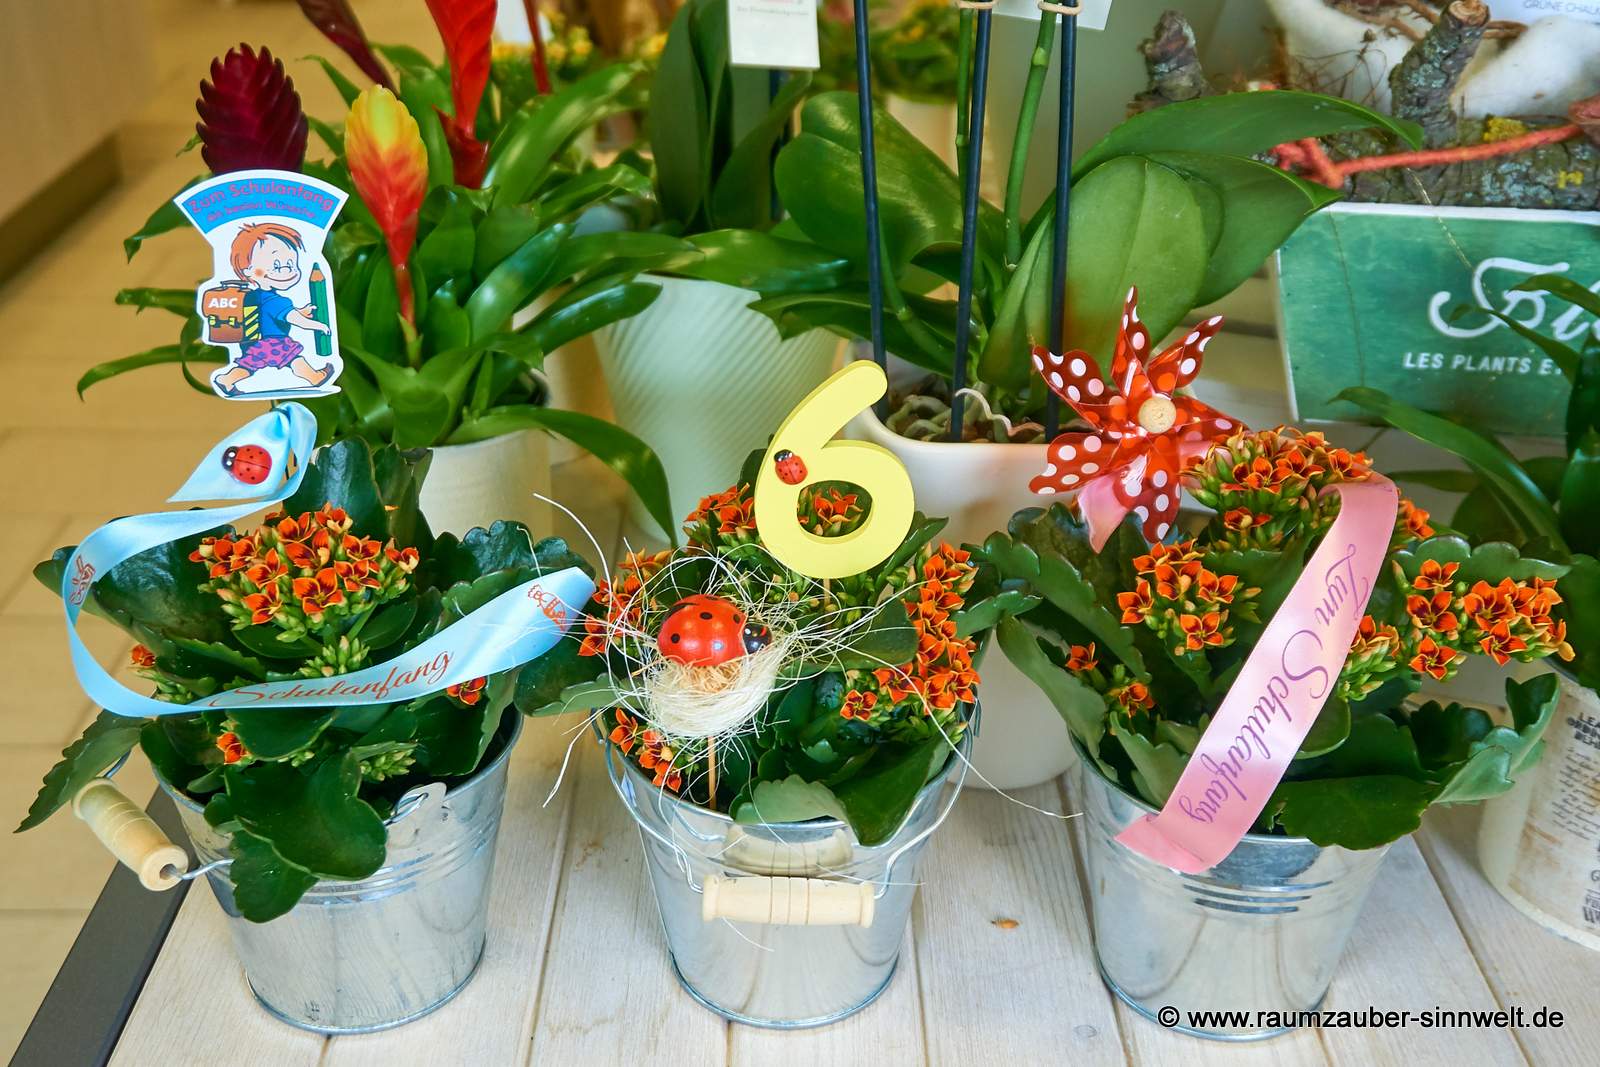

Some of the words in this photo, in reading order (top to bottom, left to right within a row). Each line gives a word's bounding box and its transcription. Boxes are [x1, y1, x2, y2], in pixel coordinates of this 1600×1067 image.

[188, 189, 225, 214] Zum
[228, 181, 335, 212] Schulanfang
[208, 297, 238, 309] ABC
[1403, 352, 1445, 369] LES
[1452, 354, 1532, 374] PLANTS
[754, 360, 915, 579] 6
[1315, 543, 1369, 627] Zum
[208, 650, 455, 707] Schulanfang
[1178, 629, 1329, 824] Schulanfang
